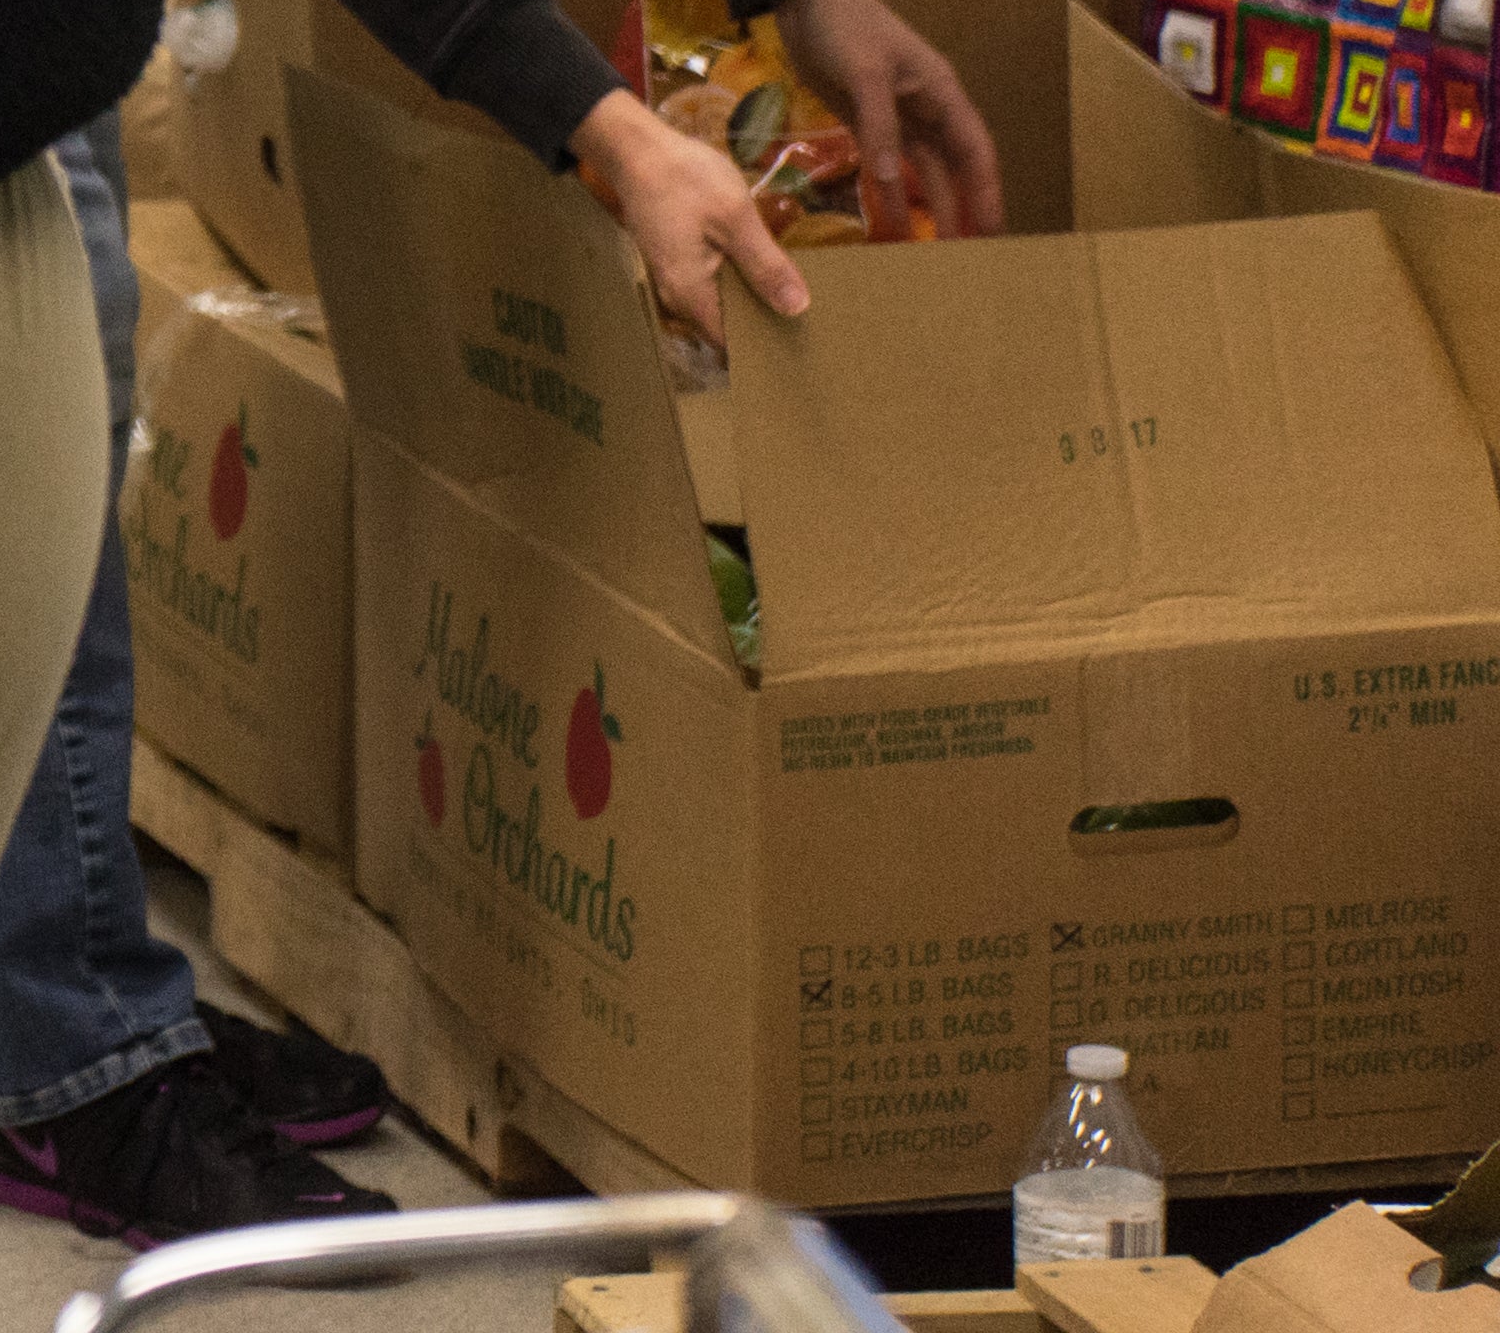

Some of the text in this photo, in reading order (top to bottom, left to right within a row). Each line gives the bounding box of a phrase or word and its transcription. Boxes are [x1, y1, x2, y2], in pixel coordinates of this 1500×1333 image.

[1090, 425, 1107, 457] 8
[1129, 416, 1157, 449] 17
[413, 581, 540, 769] Malone
[1294, 655, 1500, 702] U.S. EXTRA FANC
[462, 741, 637, 962] Orchards
[1092, 911, 1274, 950] GRANNY SMITH
[1324, 897, 1450, 931] MELROSE
[843, 945, 900, 971] 12-3
[956, 932, 1030, 962] BAGS
[1127, 945, 1272, 986] DELICIOUS
[1324, 933, 1469, 968] CORTLAND
[841, 981, 884, 1009] 8-5
[942, 971, 1015, 1000] BAGS
[1124, 983, 1268, 1019] DELICIOUS
[1323, 969, 1466, 1005] MCINTOSH
[841, 1018, 883, 1046] 5-8
[943, 1008, 1015, 1037] BAGS
[1110, 1027, 1230, 1059] NATHAN
[1322, 1010, 1423, 1041] EMPIRE
[841, 1054, 900, 1083] 4-10
[957, 1045, 1030, 1075] BAGS
[1322, 1040, 1496, 1079] HONEYCRISP
[841, 1088, 972, 1121] STAYMAN
[841, 1123, 994, 1160] EVERCRISP
